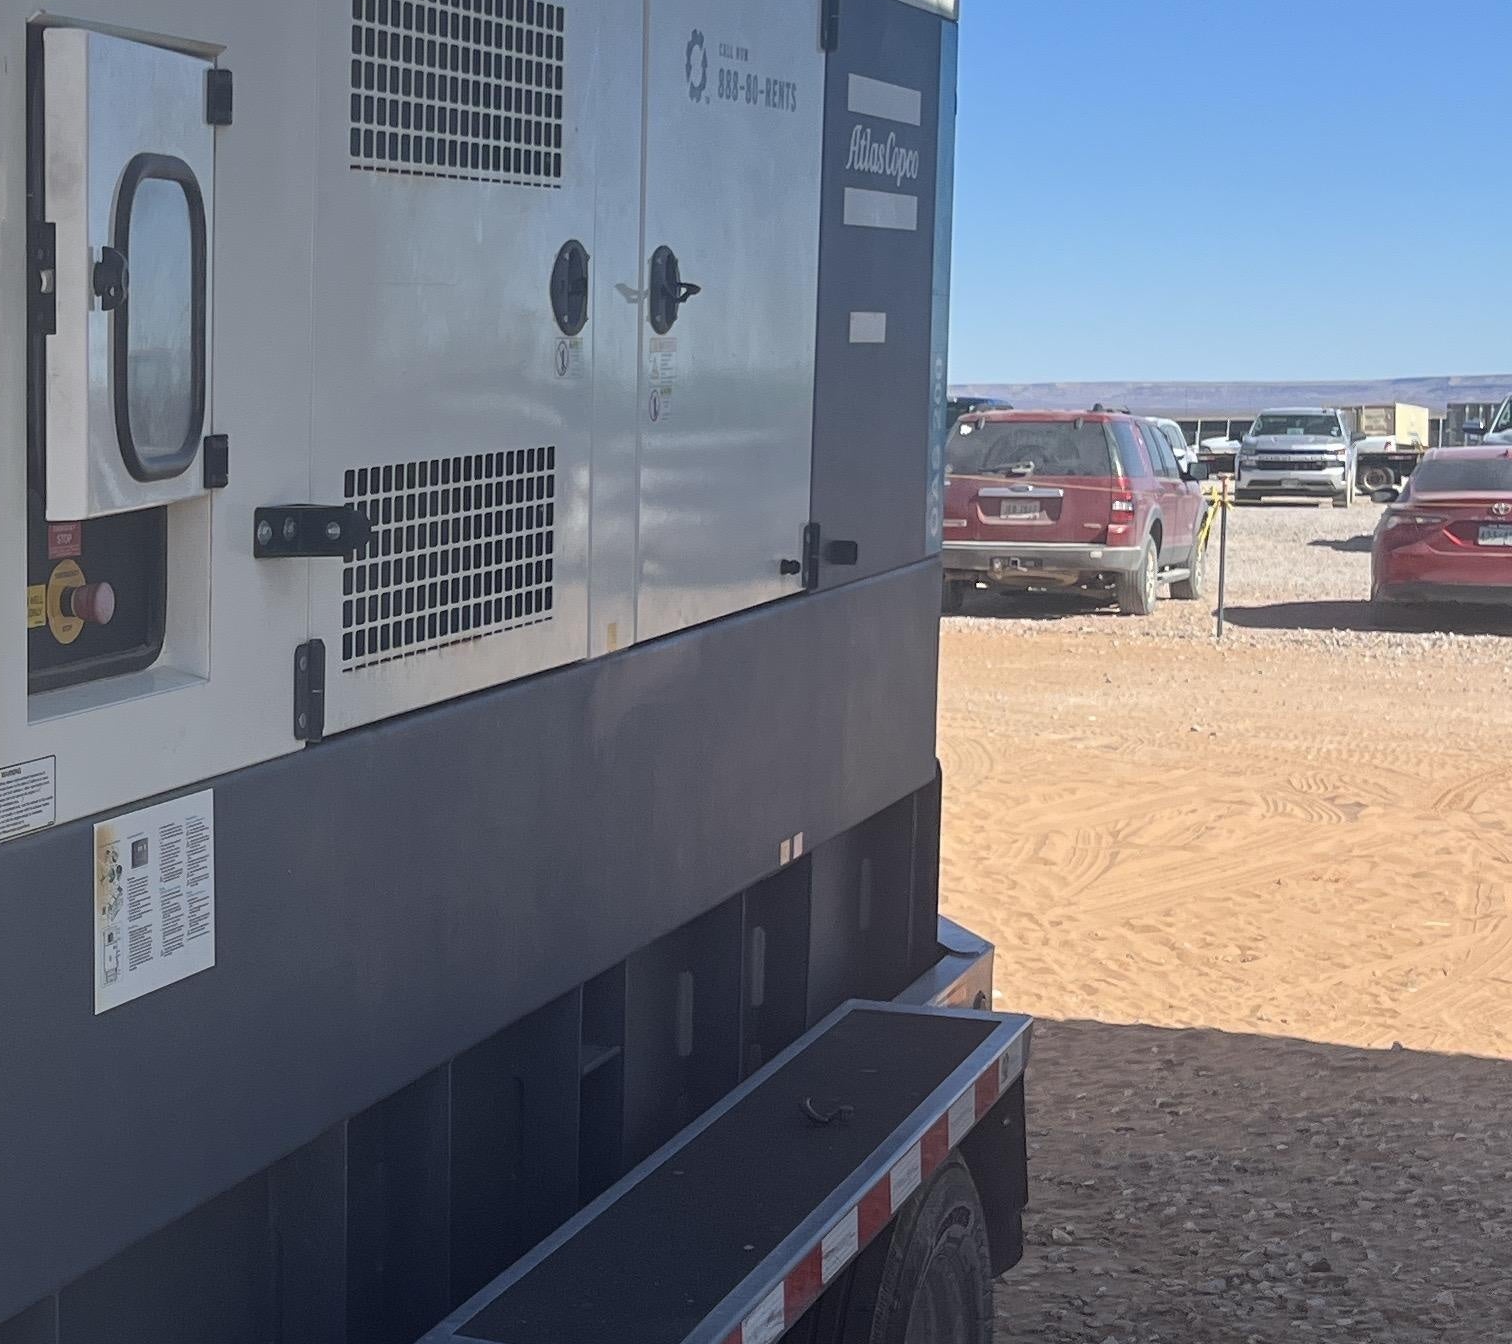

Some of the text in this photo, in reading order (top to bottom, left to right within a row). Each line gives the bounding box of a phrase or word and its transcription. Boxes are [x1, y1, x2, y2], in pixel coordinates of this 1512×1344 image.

[717, 67, 797, 112] 888-80-RENTS
[845, 124, 919, 187] Atlas Copco
